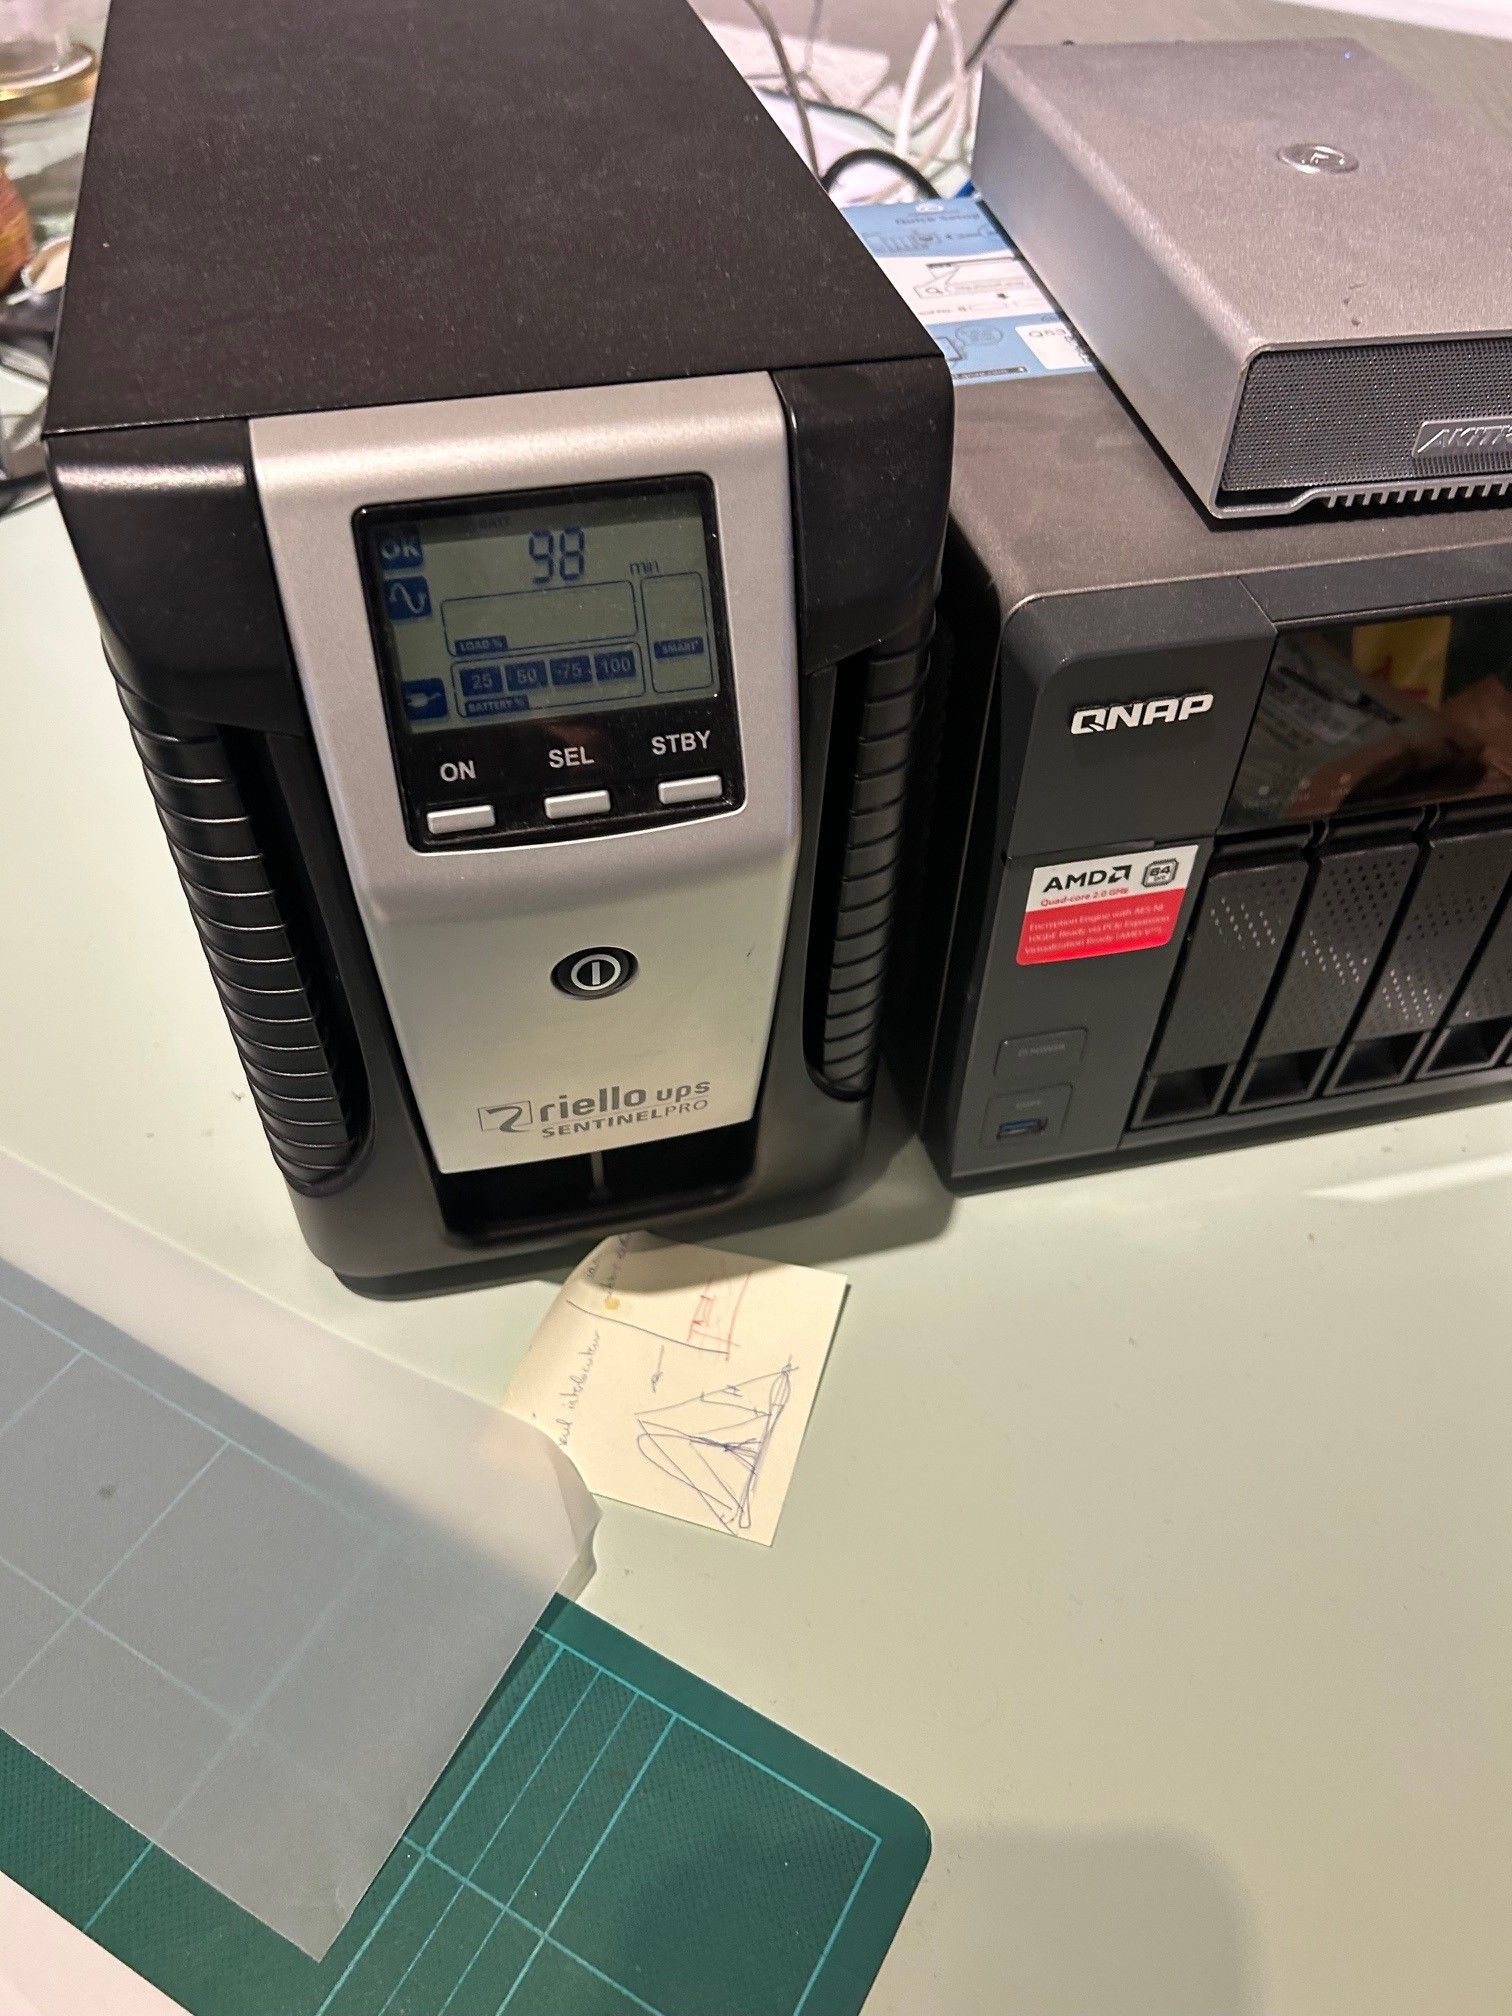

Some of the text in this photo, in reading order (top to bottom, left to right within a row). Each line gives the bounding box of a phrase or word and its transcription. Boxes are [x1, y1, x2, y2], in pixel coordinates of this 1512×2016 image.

[528, 525, 586, 585] 98
[629, 560, 660, 576] min
[517, 667, 537, 684] 50
[601, 656, 631, 674] 100
[471, 674, 493, 690] 25
[467, 699, 516, 713] BATTERY
[1070, 693, 1214, 735] QNAP
[651, 731, 711, 756] STBY
[548, 746, 595, 769] SEL
[440, 760, 476, 783] ON
[1043, 869, 1107, 893] AMD
[1150, 865, 1171, 876] 64
[539, 1080, 711, 1122] riello ups
